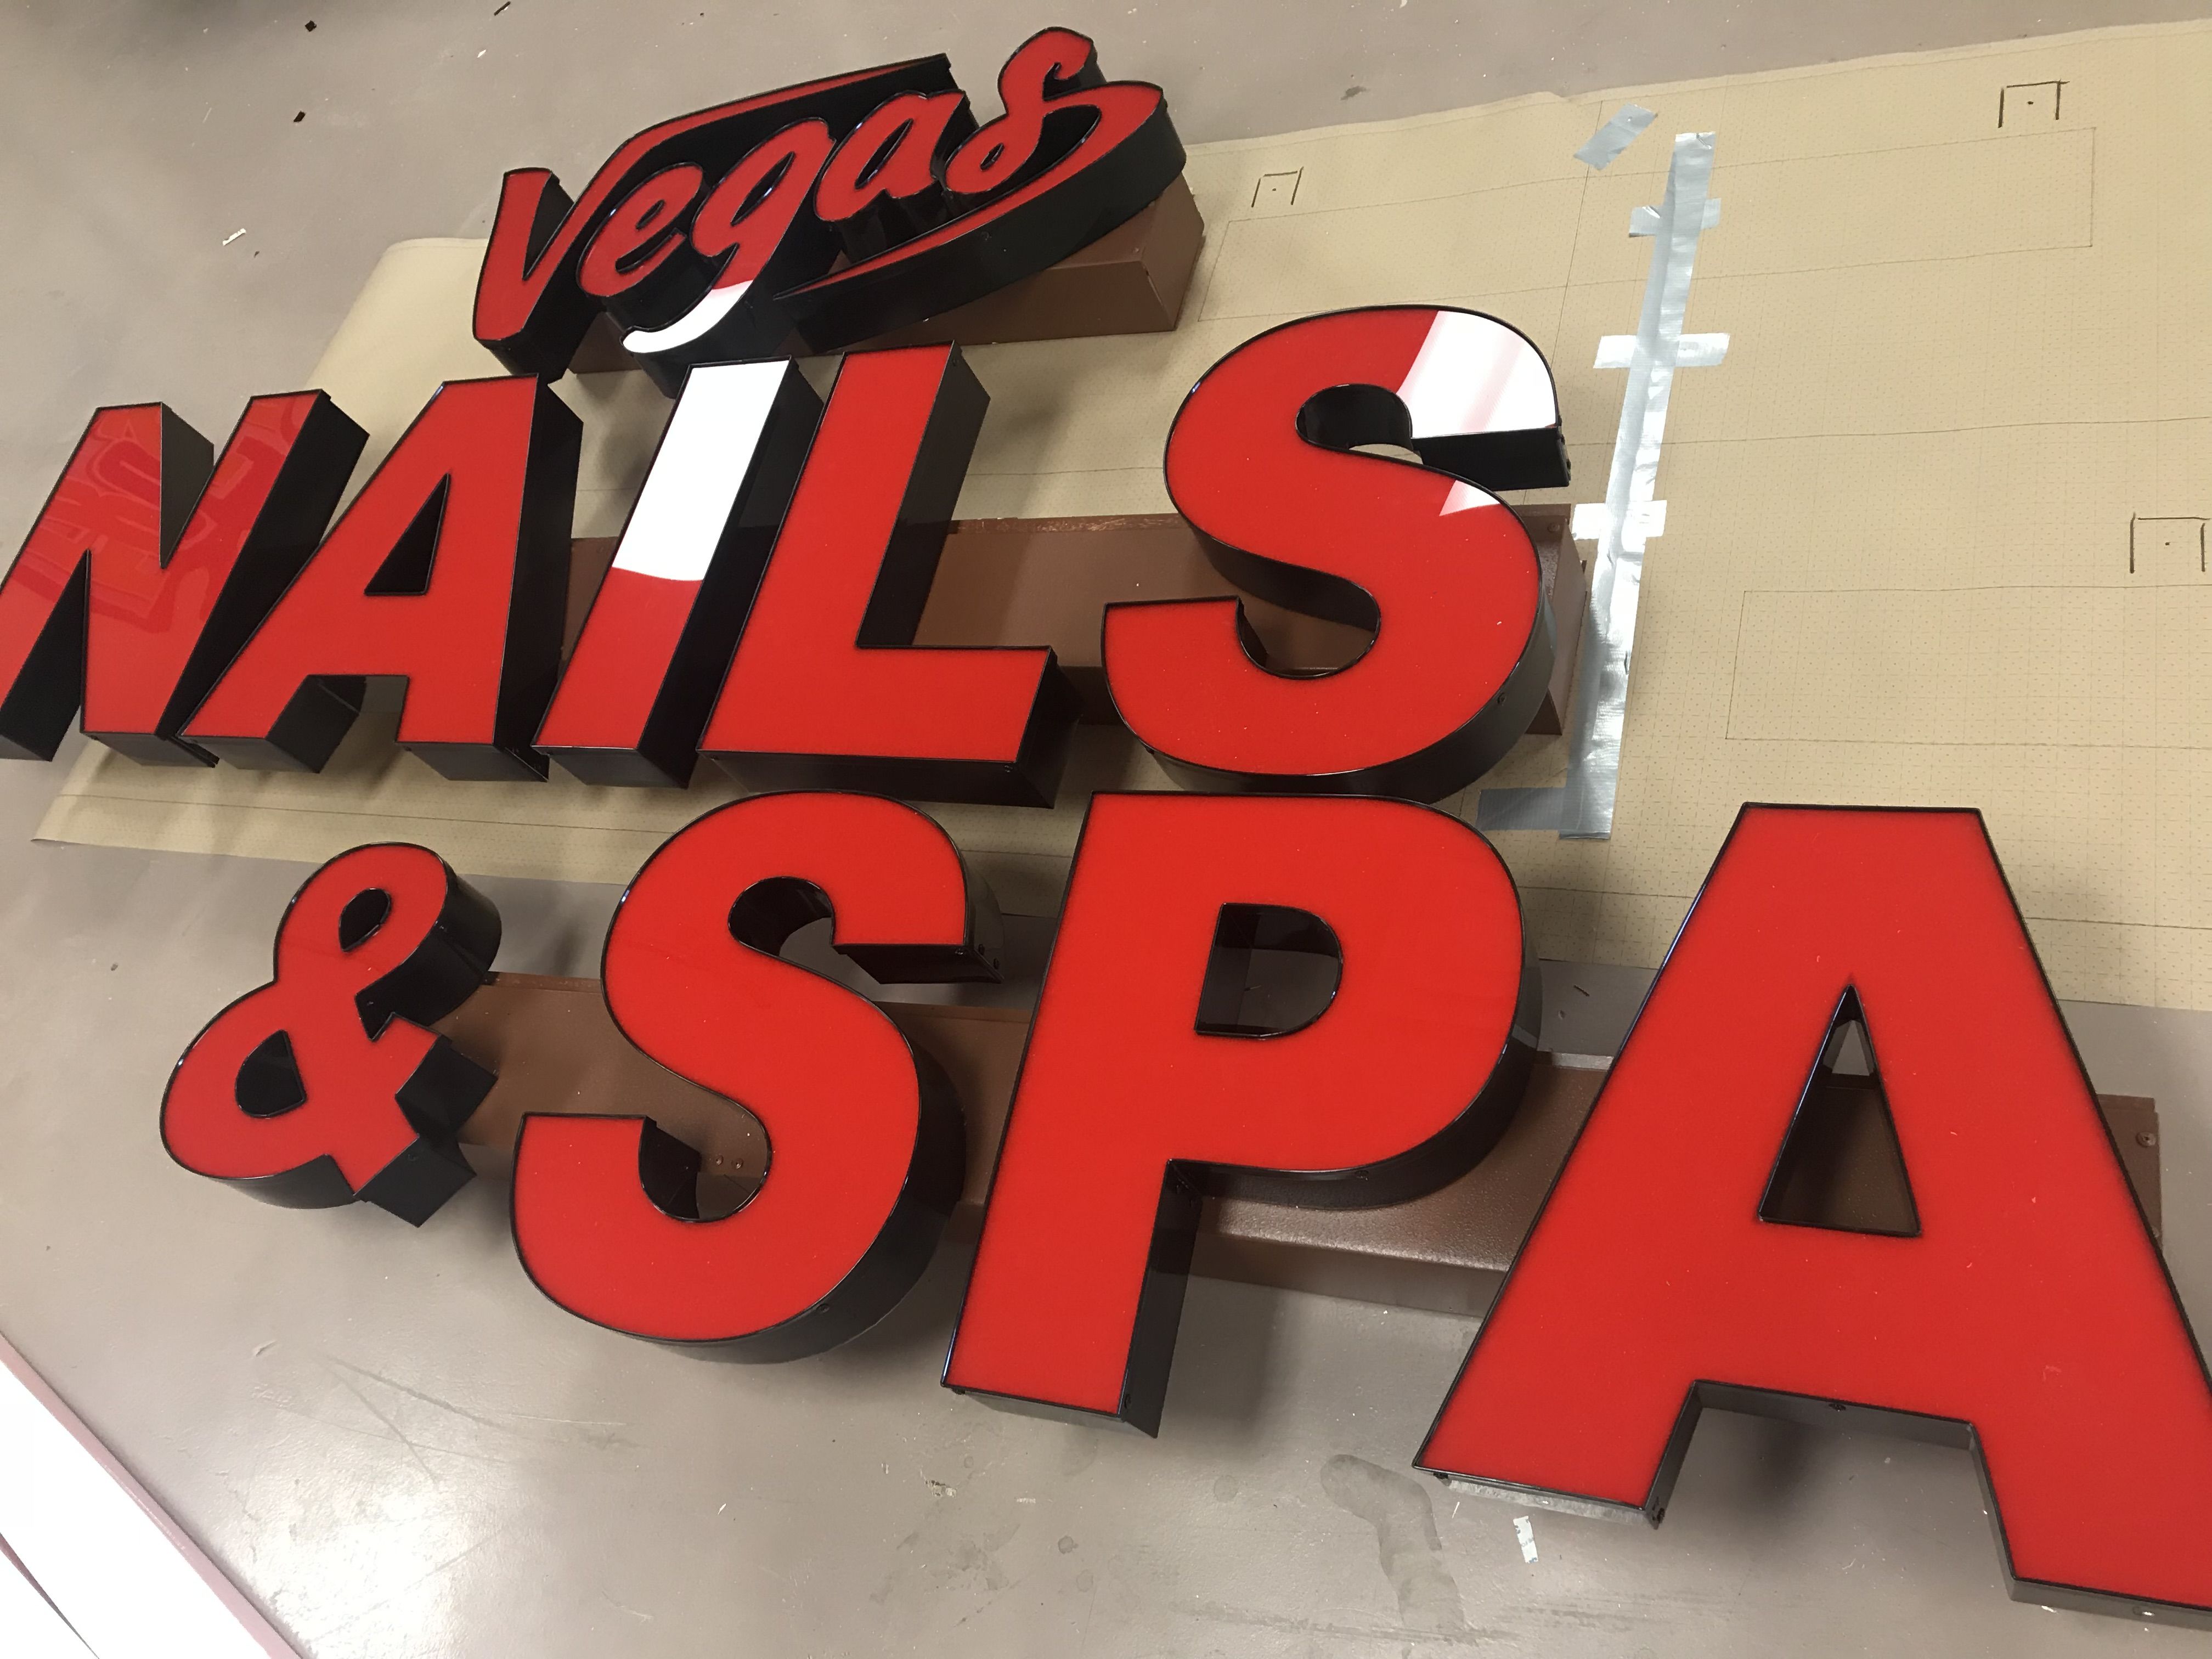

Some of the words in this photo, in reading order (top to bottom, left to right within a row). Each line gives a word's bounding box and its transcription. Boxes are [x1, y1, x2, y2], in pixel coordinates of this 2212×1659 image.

[472, 26, 1165, 354] Vegas
[0, 348, 1561, 778] NAILS
[159, 842, 447, 1199] &
[511, 789, 2212, 1613] SPA
